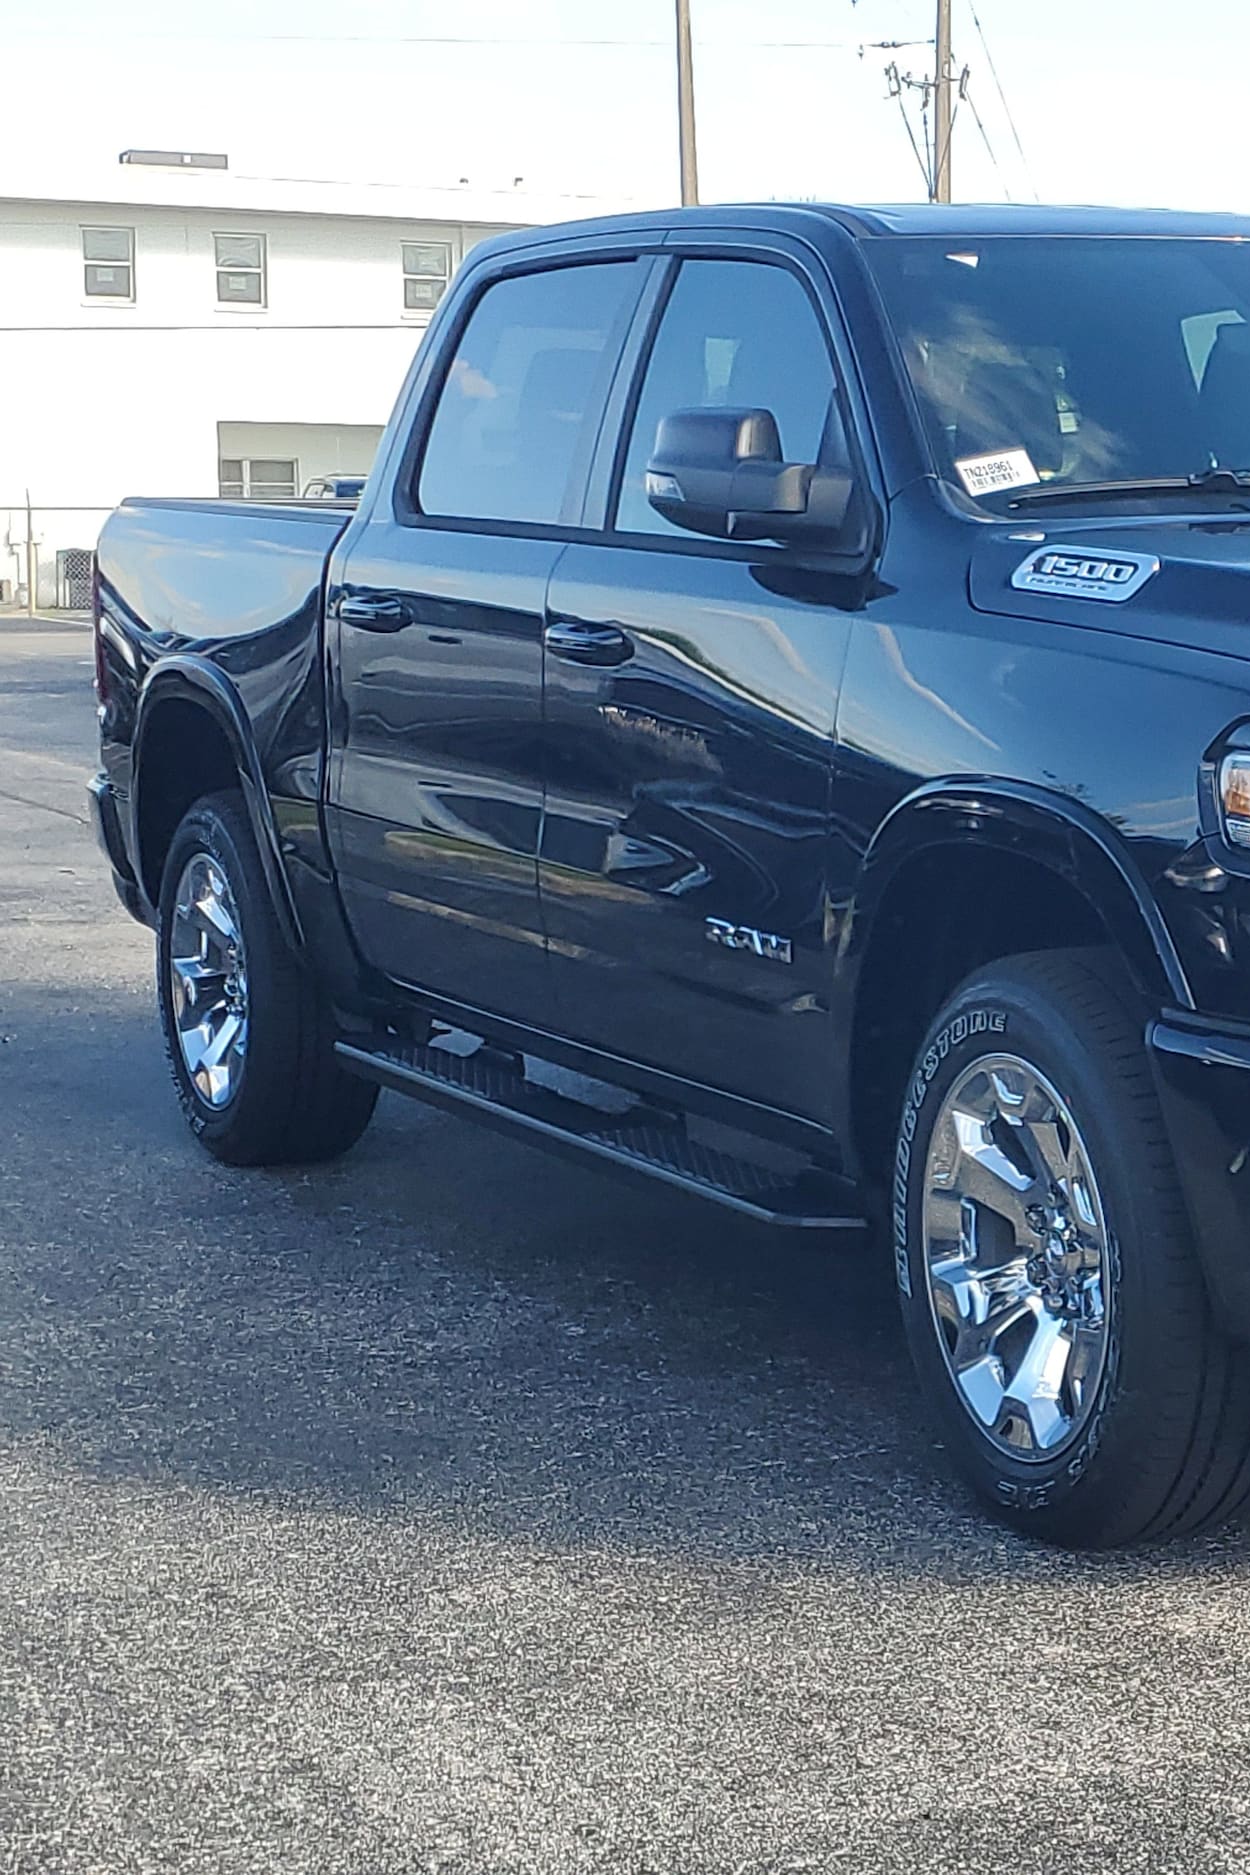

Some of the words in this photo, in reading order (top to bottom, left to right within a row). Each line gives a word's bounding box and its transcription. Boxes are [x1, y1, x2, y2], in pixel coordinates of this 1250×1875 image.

[1040, 555, 1134, 583] 1500
[705, 917, 792, 963] RAM
[894, 1010, 1007, 1298] BRIDGESTONE
